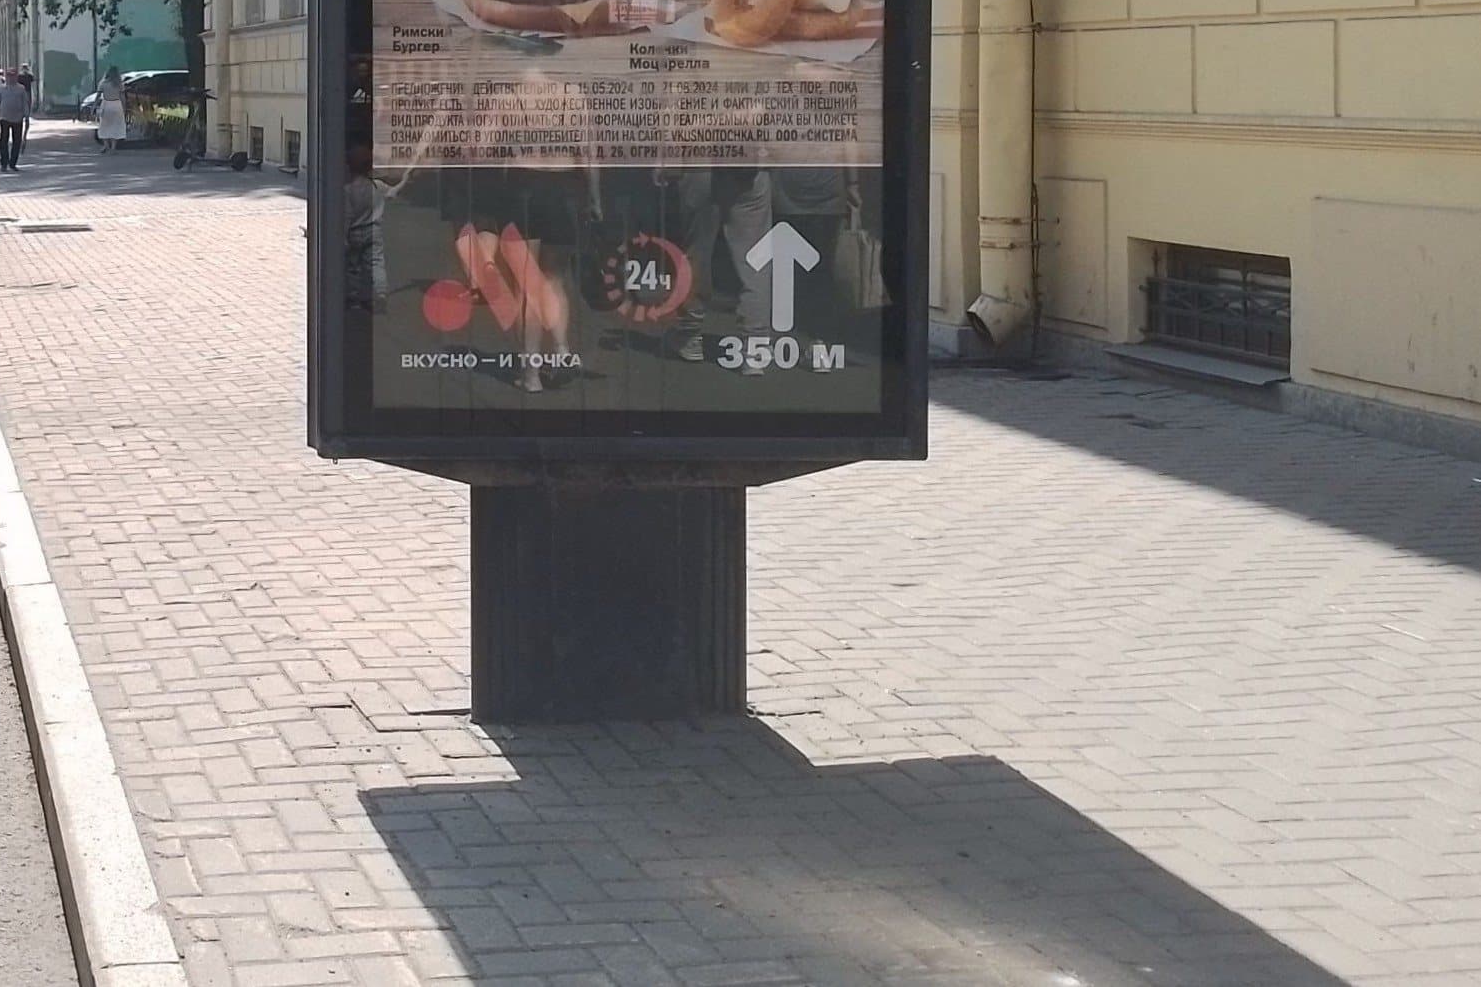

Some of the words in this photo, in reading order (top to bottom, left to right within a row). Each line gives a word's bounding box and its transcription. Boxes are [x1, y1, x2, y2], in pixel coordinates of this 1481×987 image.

[392, 40, 440, 54] Бургер
[630, 42, 688, 55] Колчки
[777, 82, 794, 94] ТЕХ
[830, 82, 858, 94] ПОКА
[391, 98, 435, 111] ПРОДУКТ
[439, 98, 463, 111] ЕСТЬ
[535, 98, 626, 111] ХУДОЖЕСТВЕННОЕ
[629, 98, 707, 110] ИЗОБЕНИЕ
[710, 98, 718, 110] И
[723, 96, 799, 110] ФАКТИЧЕСКИЙ
[803, 96, 857, 110] ВНЕШНИЙ
[391, 114, 412, 127] ВИД
[414, 114, 464, 127] ПРОДУКТА
[570, 114, 576, 126] С
[579, 112, 660, 128] ИНФОРМАЦИЕЙ
[663, 114, 671, 126] О
[673, 114, 749, 126] РЕАЛИЗУЕМЫХ
[751, 114, 794, 126] ТОВАРАХ
[796, 114, 811, 126] ВЫ
[814, 114, 858, 126] МОЖЕТЕ
[391, 130, 473, 143] ОЗНАКОМИТЬСЯ
[474, 130, 481, 142] В
[483, 130, 519, 143] УГОЛКЕ
[596, 130, 619, 142] ИЛИ
[622, 130, 635, 142] НА
[638, 128, 669, 142] САЙТЕ
[776, 130, 798, 142] ООО
[630, 146, 658, 158] ОГРН
[401, 353, 477, 368] ВКУСНО
[499, 353, 513, 368] И
[517, 353, 581, 368] ТОЧКА
[718, 337, 799, 369] 350
